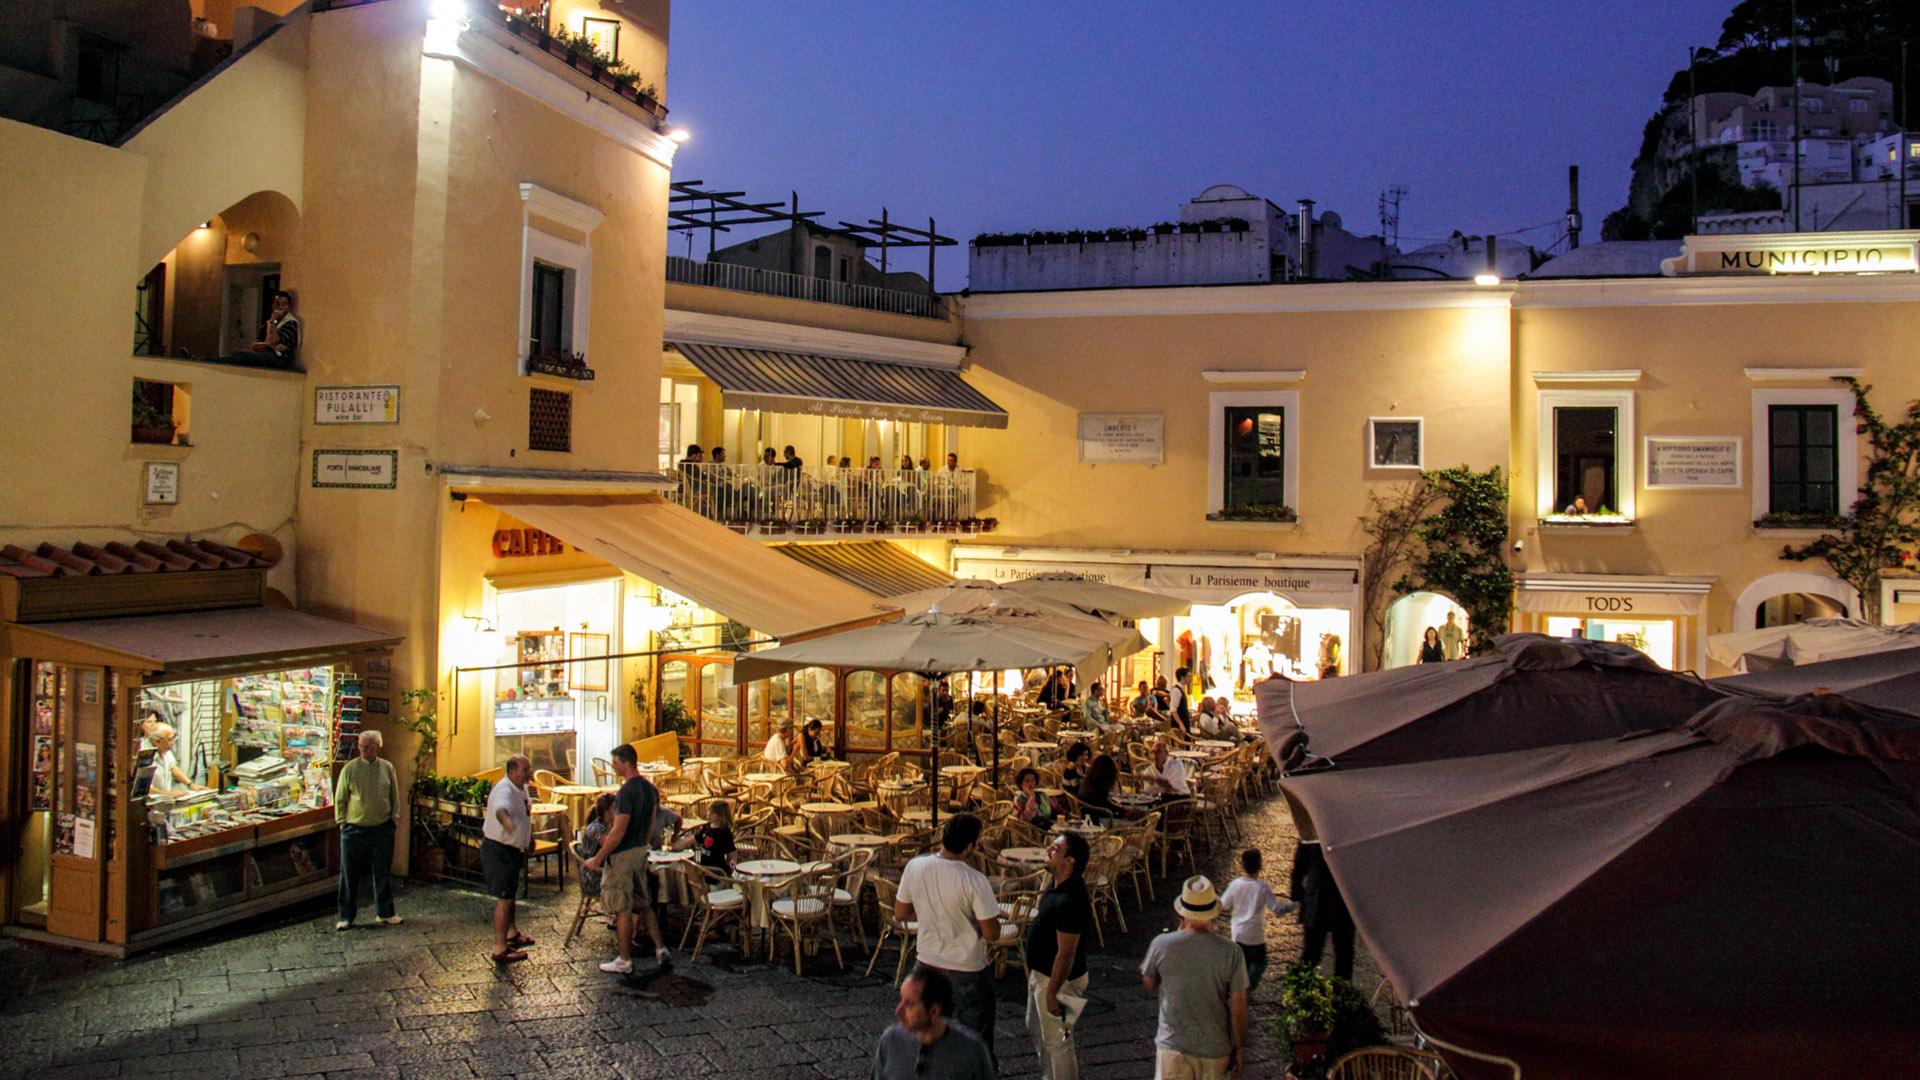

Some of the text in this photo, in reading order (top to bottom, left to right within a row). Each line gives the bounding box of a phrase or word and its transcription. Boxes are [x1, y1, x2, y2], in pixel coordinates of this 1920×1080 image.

[1721, 249, 1882, 268] MUNICIPIO
[318, 392, 381, 401] RISTORANTE
[327, 403, 373, 413] PULALLI
[995, 568, 1005, 578] La
[1190, 574, 1310, 590] La Parisienne boutique
[1585, 597, 1633, 611] TOD'S
